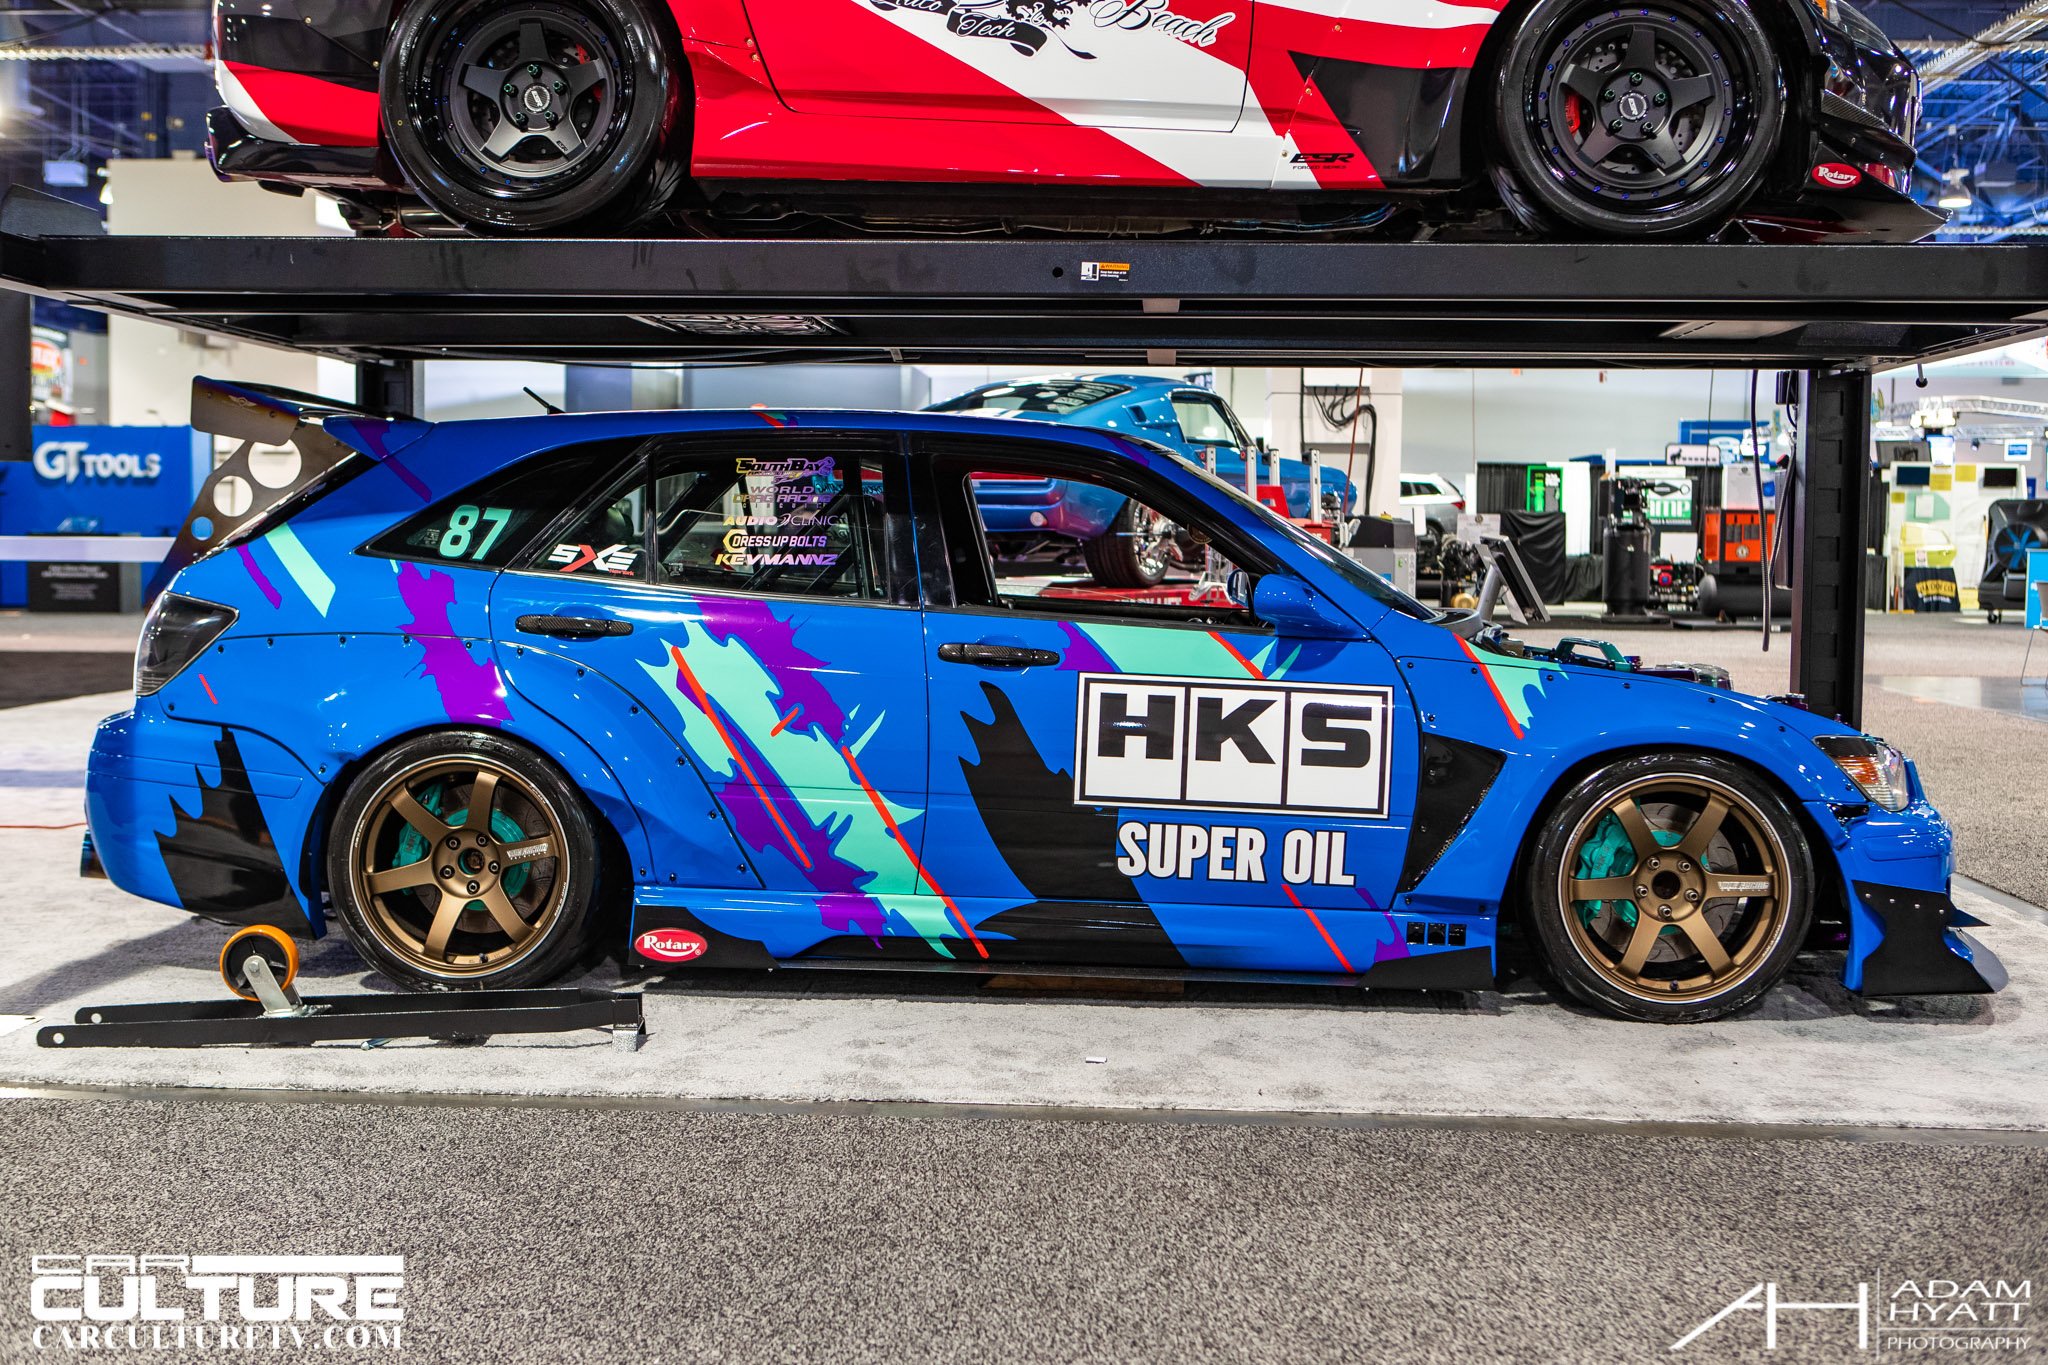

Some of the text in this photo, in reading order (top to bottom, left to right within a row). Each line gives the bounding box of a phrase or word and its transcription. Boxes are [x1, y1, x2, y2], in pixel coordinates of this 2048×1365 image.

[957, 11, 1016, 37] Tech
[1089, 0, 1233, 44] Beach
[1818, 166, 1857, 184] Rotary
[33, 440, 161, 484] GT TOOLS
[733, 494, 832, 503] DRAG RACING
[751, 486, 815, 494] WORLD
[723, 515, 839, 526] AUDIO CLINIC
[439, 504, 512, 561] 87
[789, 536, 827, 547] BOLTS
[714, 553, 840, 566] KEVMANNZ
[1097, 691, 1373, 769] HKS
[1117, 821, 1356, 887] SUPER OIL
[643, 935, 700, 956] Rotary
